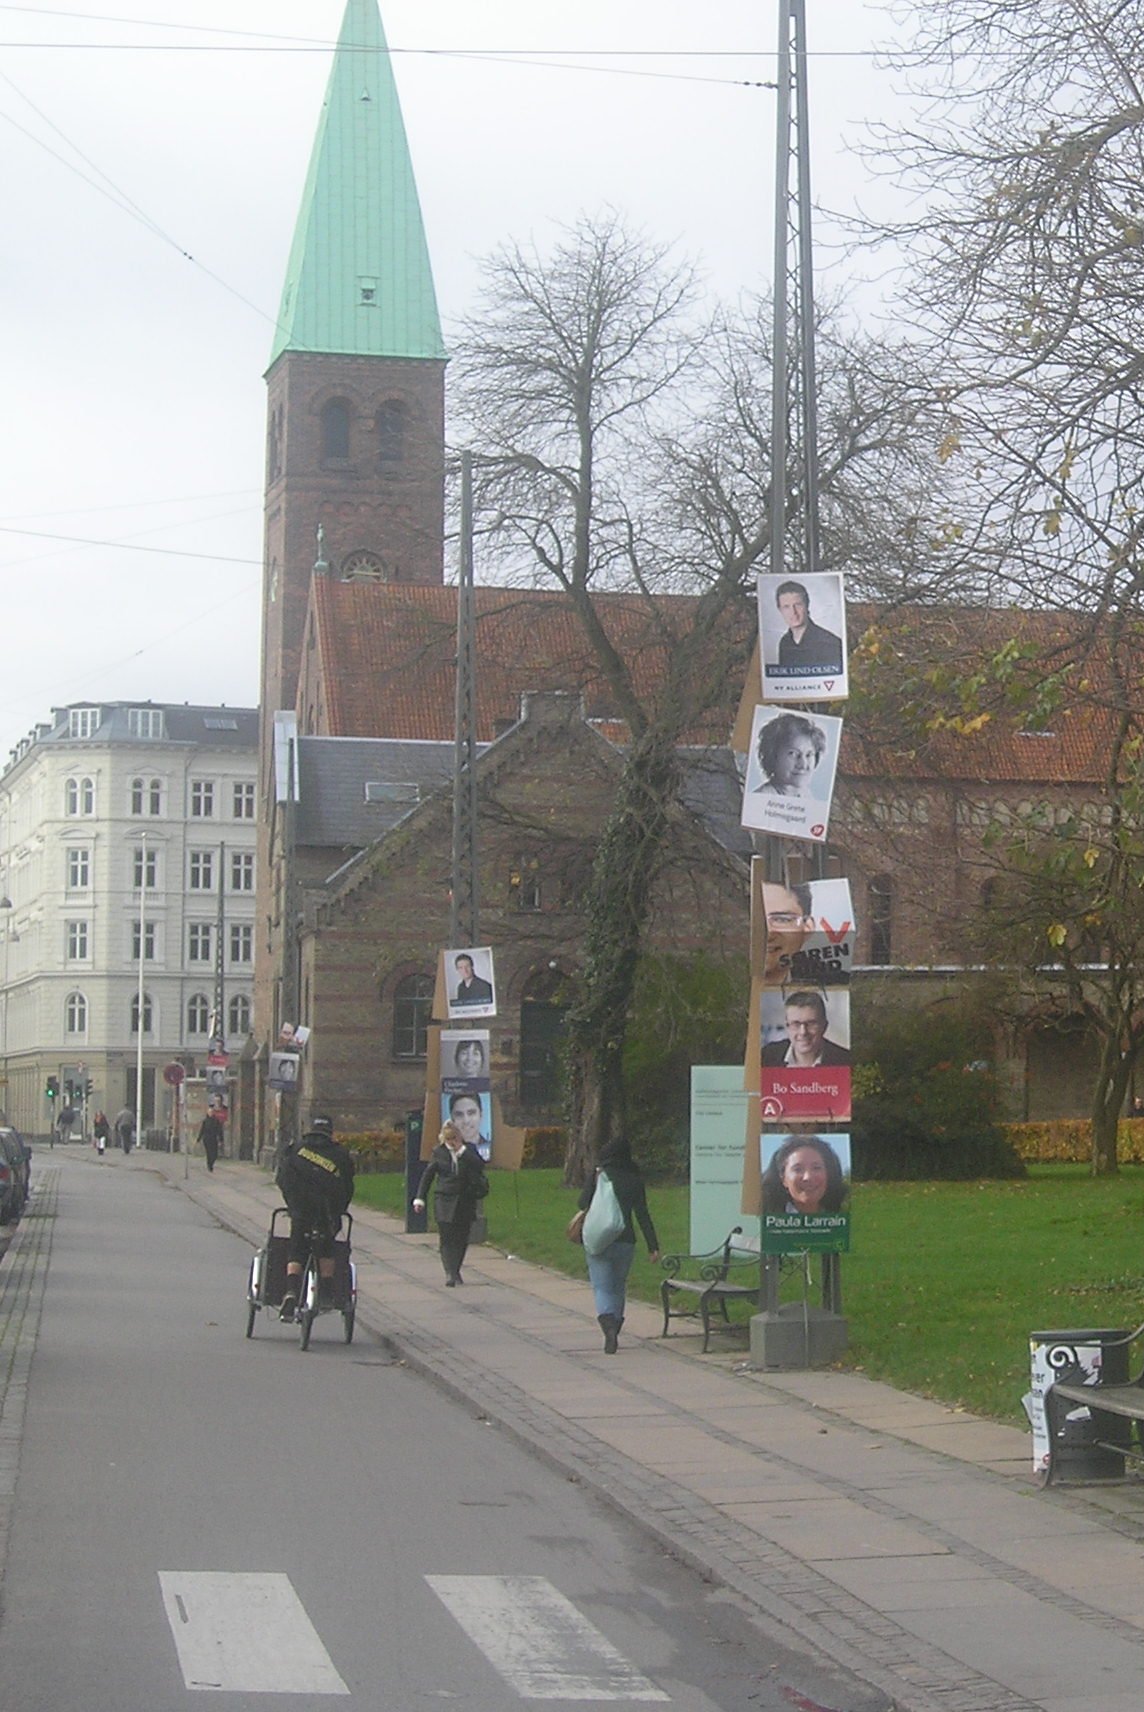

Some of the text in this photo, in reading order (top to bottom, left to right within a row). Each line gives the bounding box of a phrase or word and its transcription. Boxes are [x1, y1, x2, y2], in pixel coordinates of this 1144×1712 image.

[820, 917, 851, 944] V
[772, 1082, 839, 1096] Bo Sandberg
[763, 1102, 776, 1115] A
[766, 1215, 846, 1227] Paula Larrain
